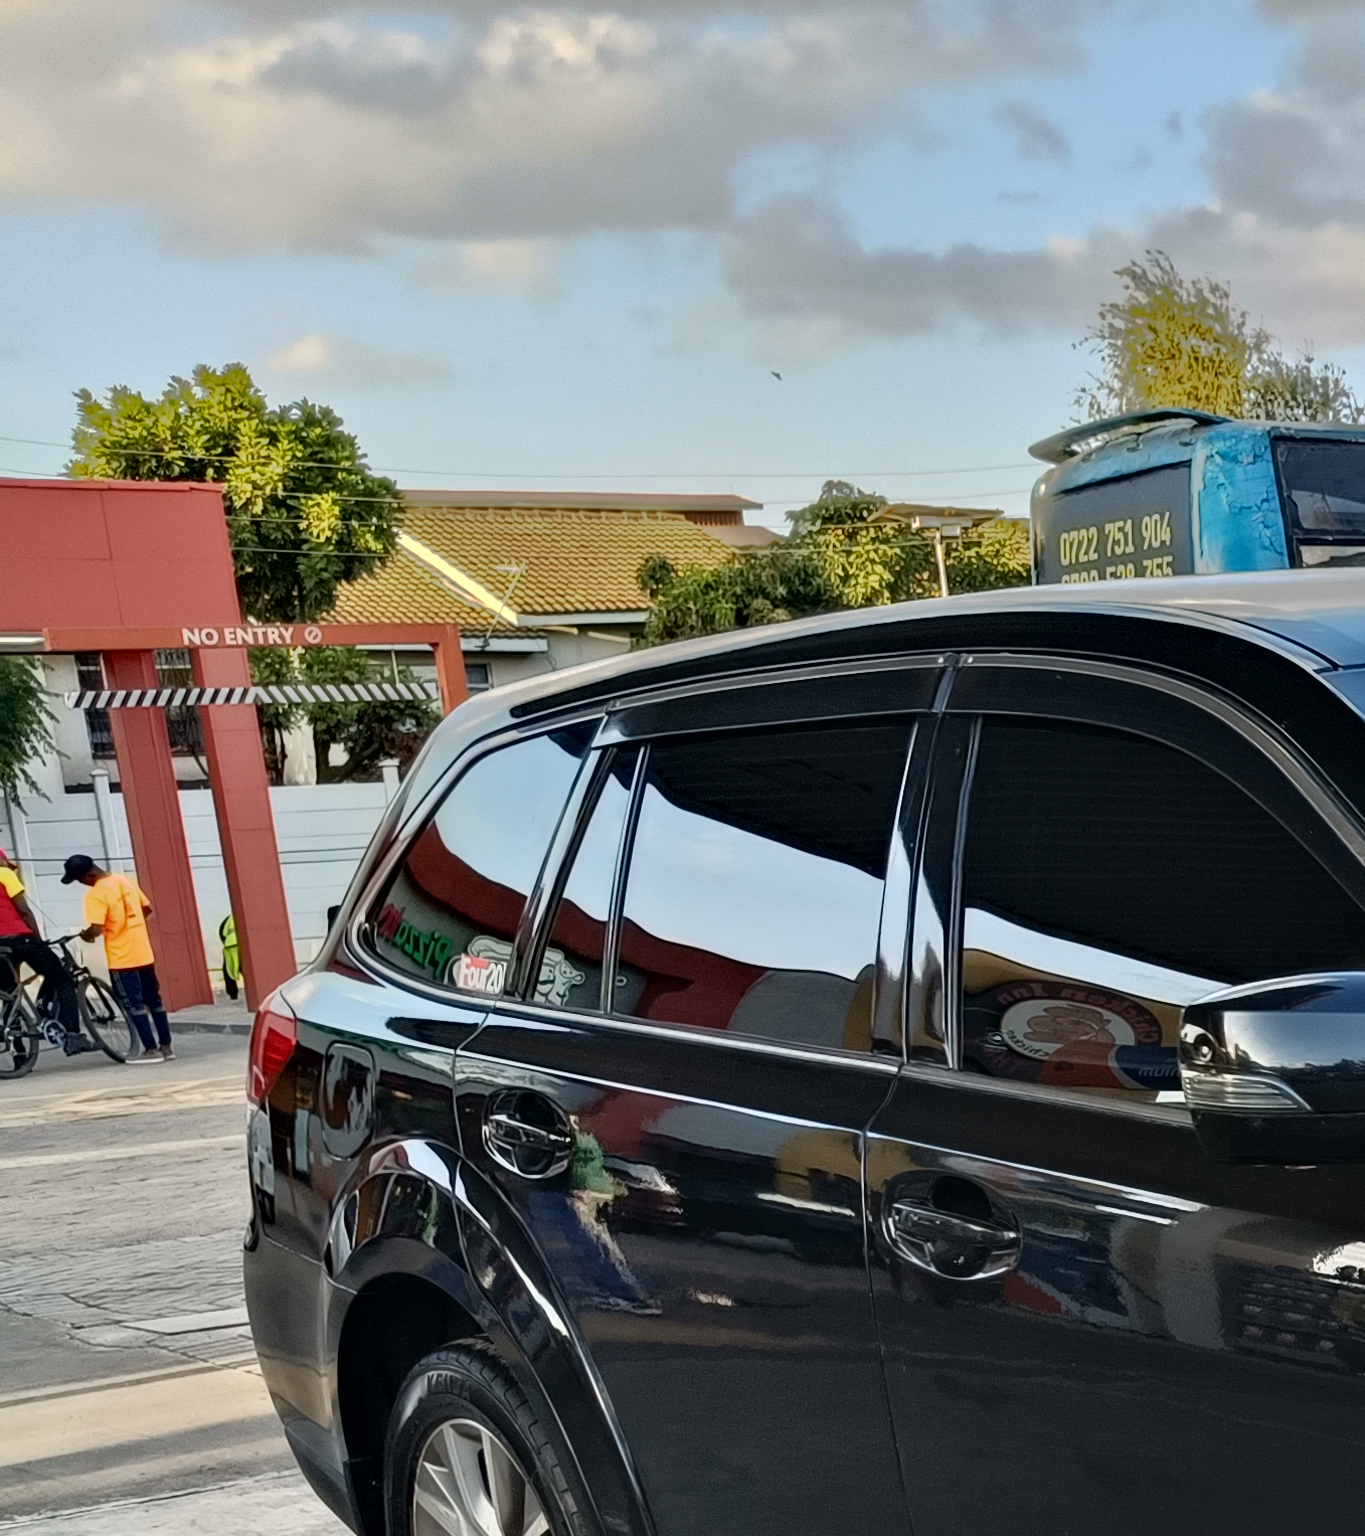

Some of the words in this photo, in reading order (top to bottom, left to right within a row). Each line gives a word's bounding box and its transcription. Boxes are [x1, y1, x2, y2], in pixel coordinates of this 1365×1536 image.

[1060, 526, 1099, 567] 0722
[1104, 518, 1135, 558] 751
[1141, 511, 1172, 551] 904
[181, 628, 219, 646] NO
[223, 626, 294, 645] ENTRY
